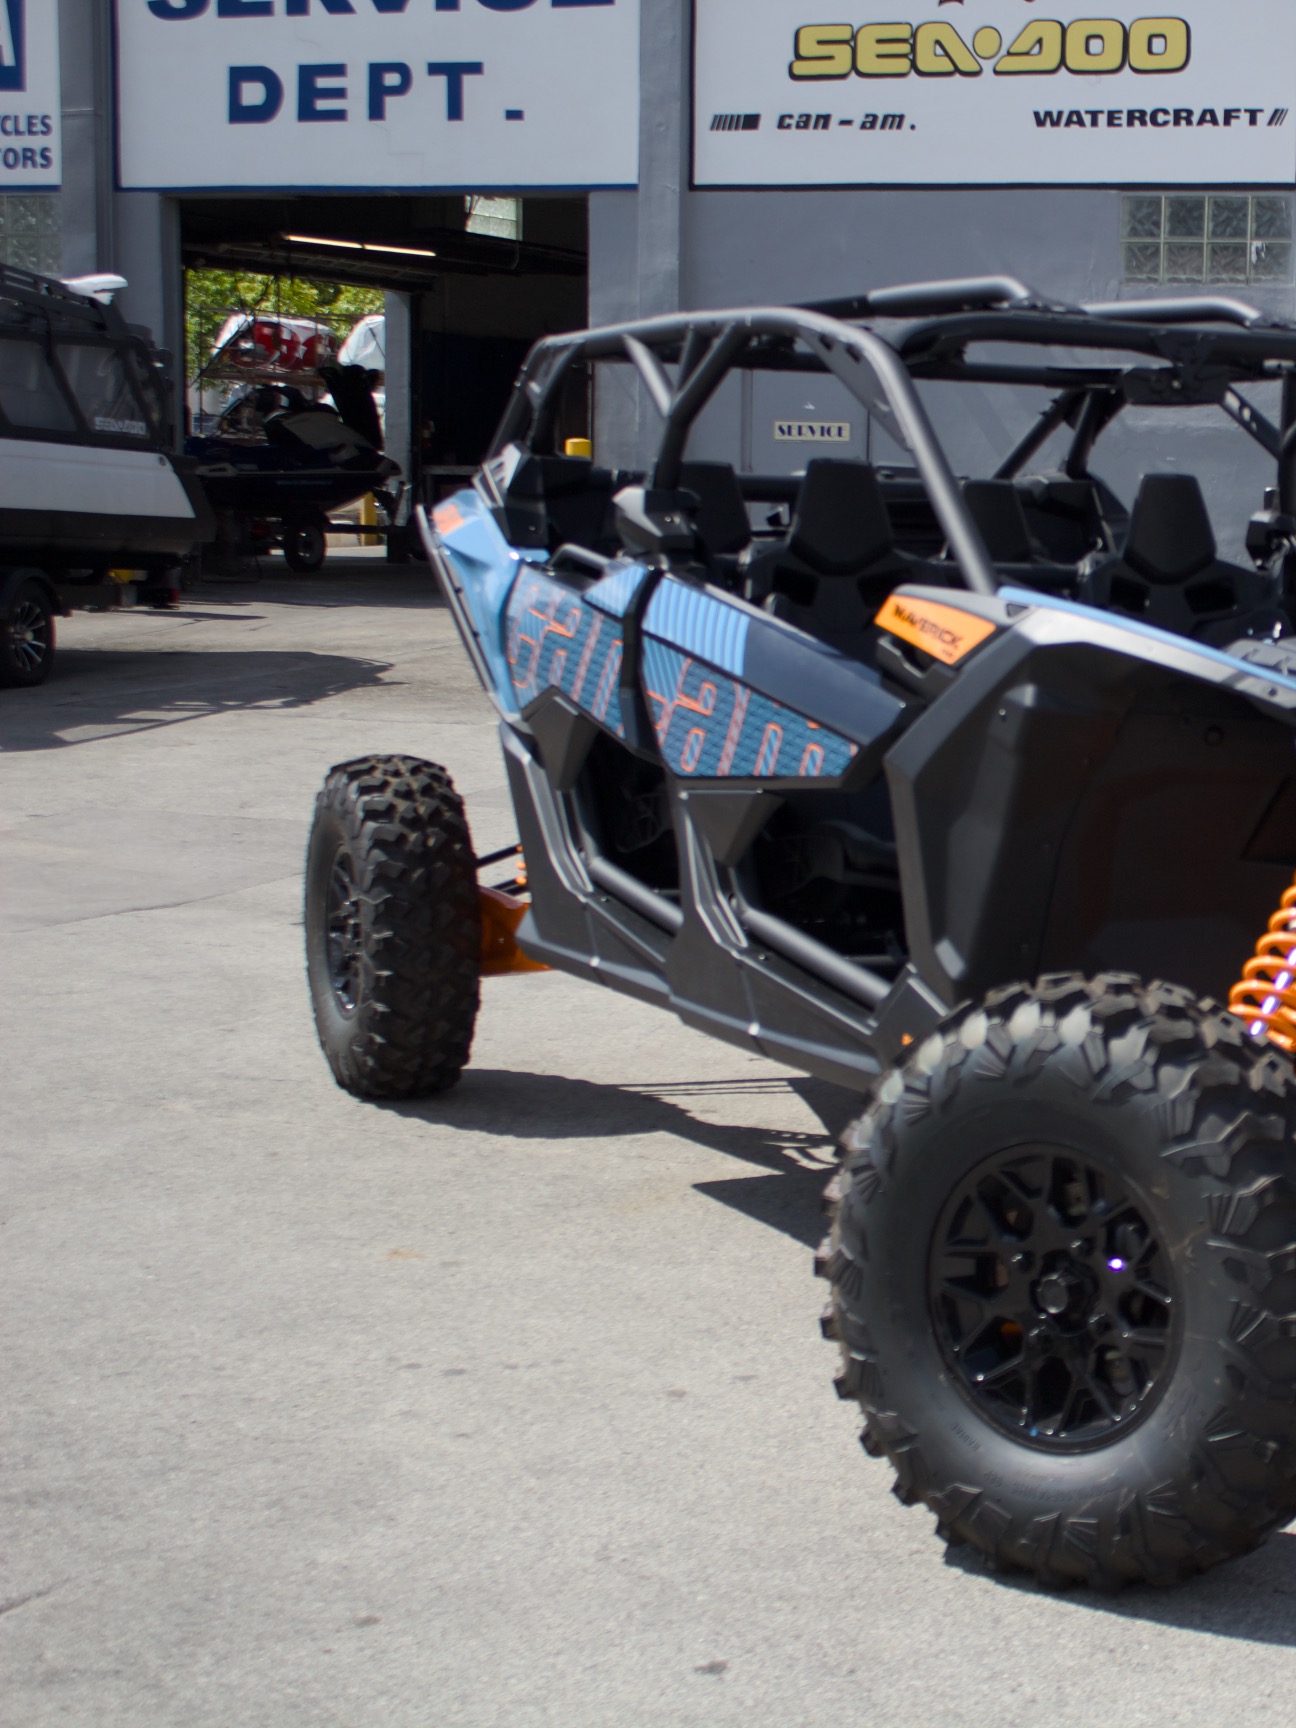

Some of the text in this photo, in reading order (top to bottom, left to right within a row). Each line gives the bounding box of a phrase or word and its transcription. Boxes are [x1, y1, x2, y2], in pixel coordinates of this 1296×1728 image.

[227, 61, 525, 125] DEPT.
[0, 114, 53, 137] CLES
[1032, 108, 1265, 128] WATERCRAFT
[0, 147, 53, 170] ORS
[777, 424, 848, 439] SERVICE
